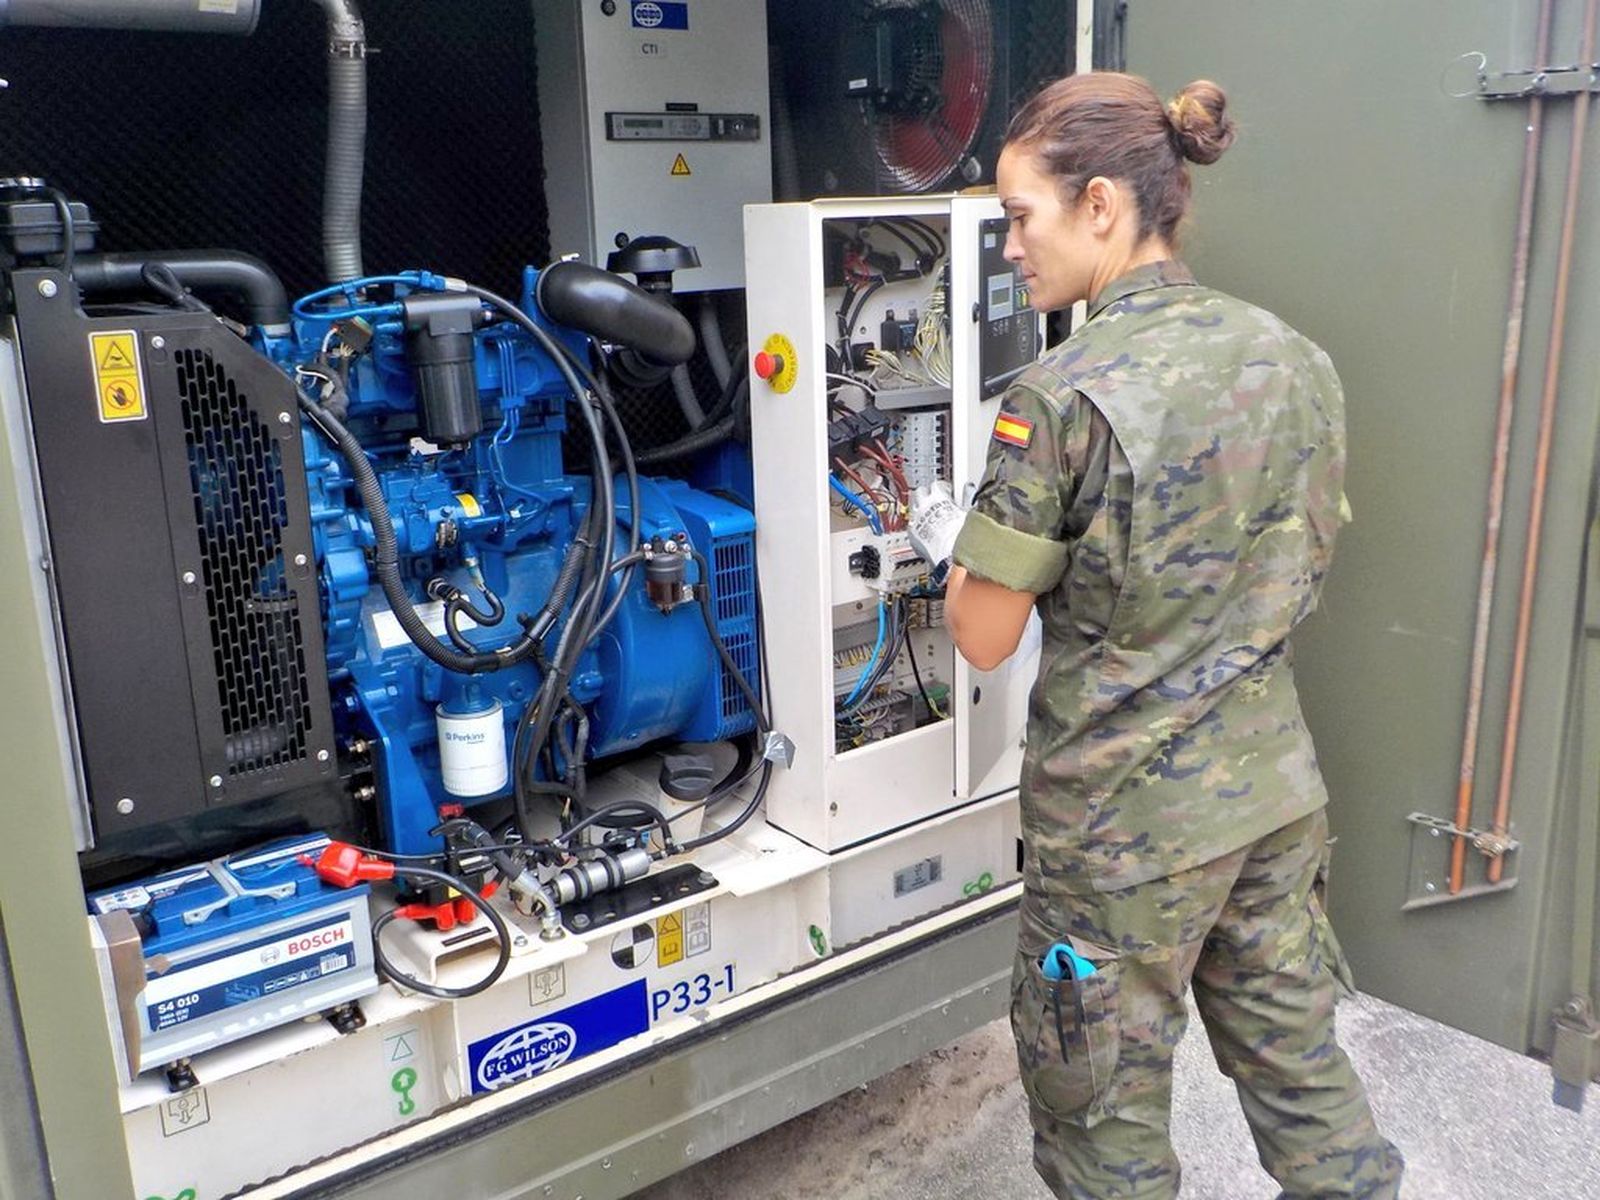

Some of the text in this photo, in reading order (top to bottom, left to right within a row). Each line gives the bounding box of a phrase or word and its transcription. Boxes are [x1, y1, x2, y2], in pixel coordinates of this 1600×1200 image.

[453, 733, 485, 741] Perkins
[288, 927, 345, 955] BOSCH
[158, 993, 200, 1014] S4 010
[652, 963, 734, 1021] P33-1
[486, 1034, 569, 1077] FG WILSON
